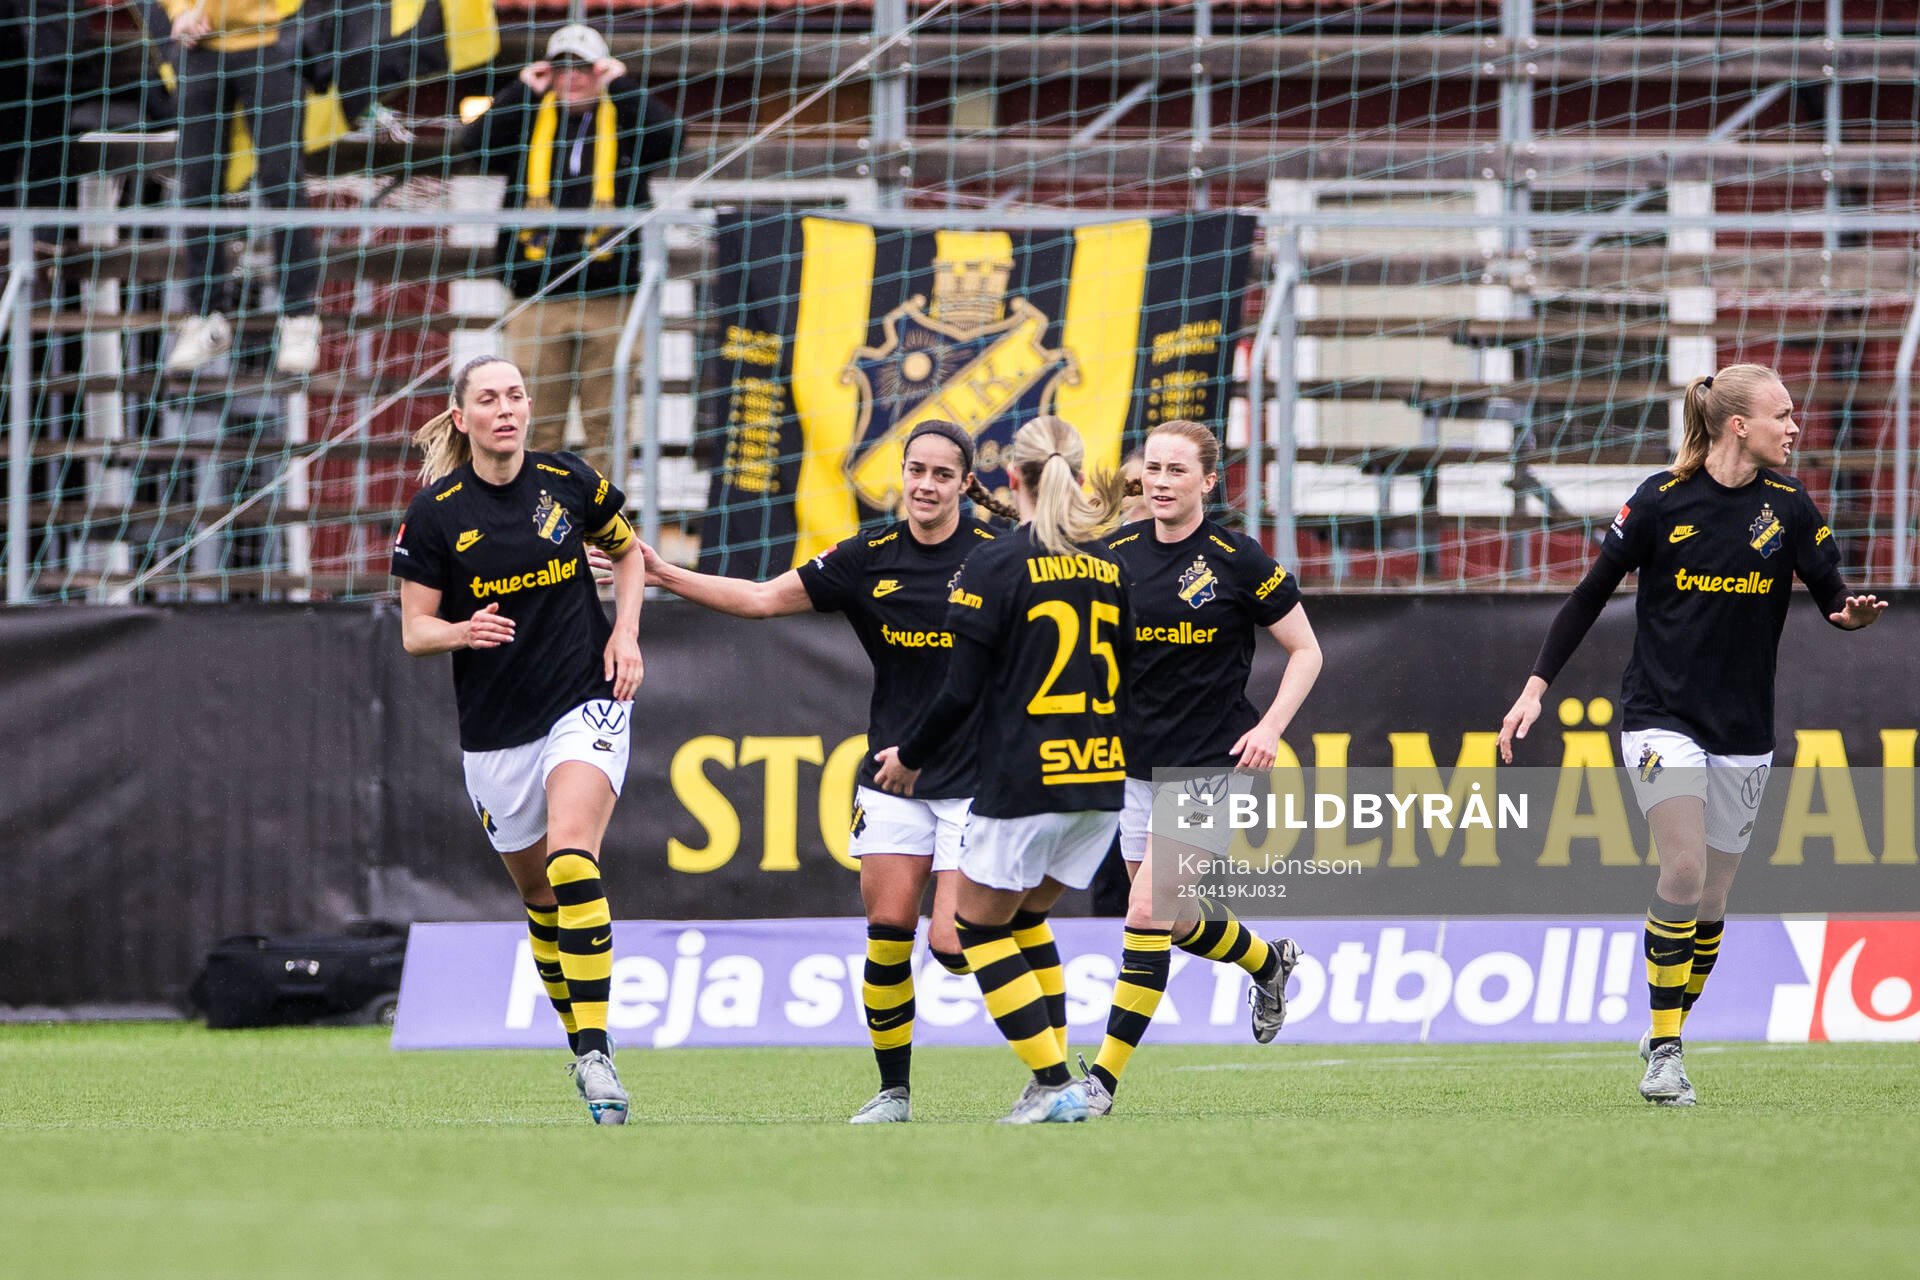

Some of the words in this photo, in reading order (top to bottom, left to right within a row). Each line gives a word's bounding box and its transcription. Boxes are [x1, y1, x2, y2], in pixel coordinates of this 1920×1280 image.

[469, 558, 578, 599] truecaller
[1674, 567, 1774, 594] truecaller
[881, 624, 956, 648] trueca
[1135, 621, 1218, 645] uecaller
[1026, 600, 1120, 715] 25
[1039, 736, 1126, 772] SVEA
